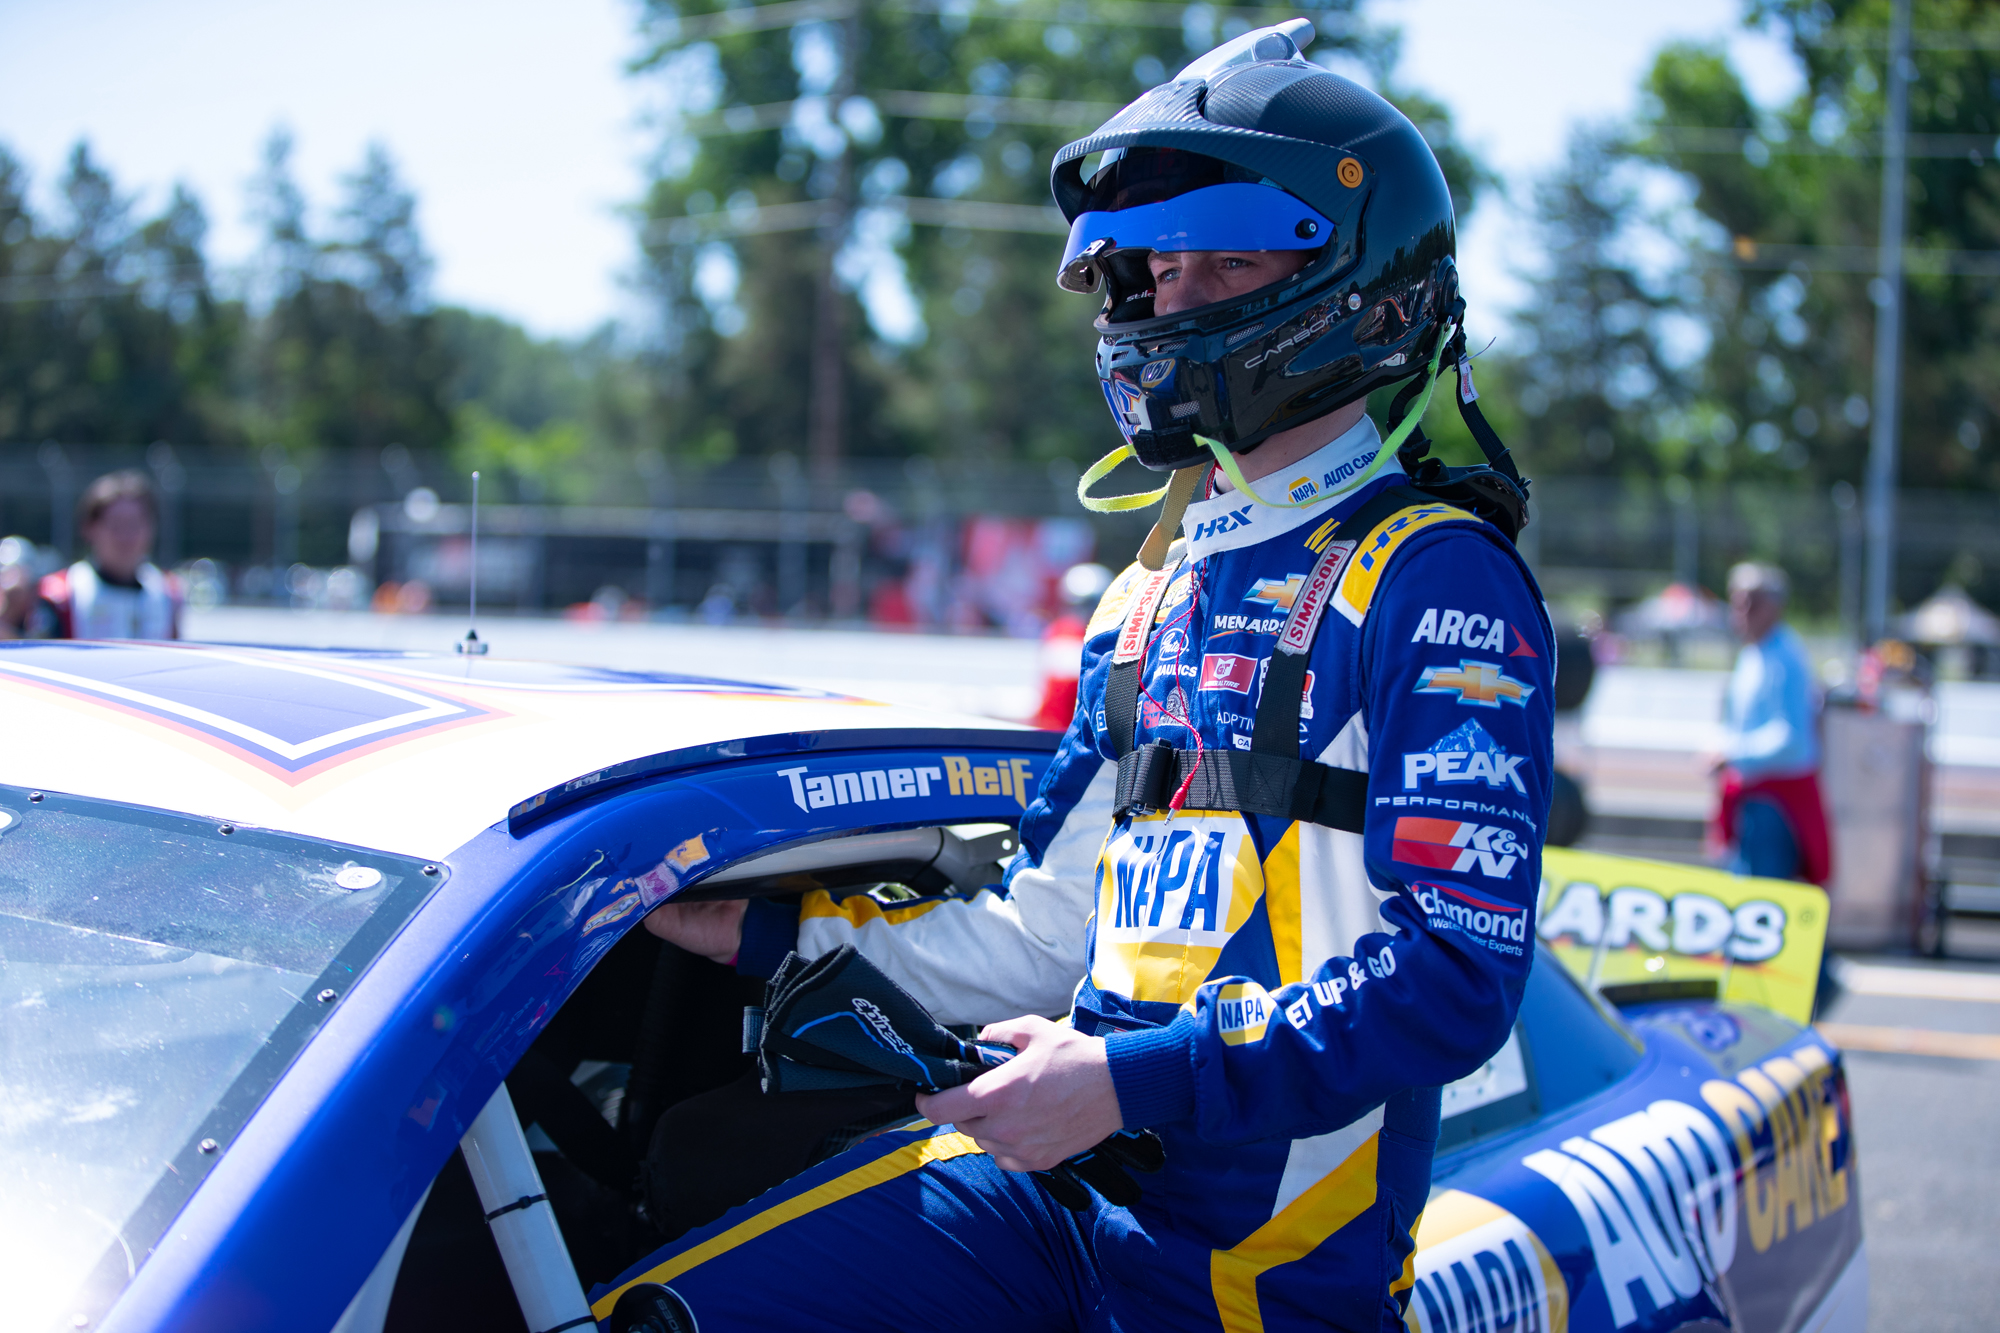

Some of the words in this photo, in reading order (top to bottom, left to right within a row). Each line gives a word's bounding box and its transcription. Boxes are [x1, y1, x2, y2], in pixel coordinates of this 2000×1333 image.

[1291, 482, 1317, 503] NAPA
[1323, 462, 1355, 489] AUTO
[1352, 450, 1380, 470] CAR
[1193, 504, 1254, 542] HRX
[1360, 506, 1452, 572] HRX
[1123, 575, 1165, 651] SIMPSON
[1290, 552, 1341, 642] SIMPSON
[1411, 608, 1504, 653] ARCA
[776, 765, 942, 813] Tanner
[941, 756, 1034, 811] Reif
[1403, 751, 1528, 795] PEAK
[1447, 821, 1529, 879] K&N
[1114, 829, 1226, 932] NAPA
[1411, 884, 1528, 943] ichmond
[1537, 881, 1787, 963] ARDS
[1488, 939, 1524, 957] Experts
[1220, 996, 1266, 1030] NAPA
[1285, 992, 1314, 1030] ET
[1313, 976, 1348, 1008] UP
[1347, 961, 1369, 991] &
[1367, 945, 1397, 979] GO
[1522, 1099, 1738, 1330] AUTO
[1700, 1045, 1849, 1253] CARE
